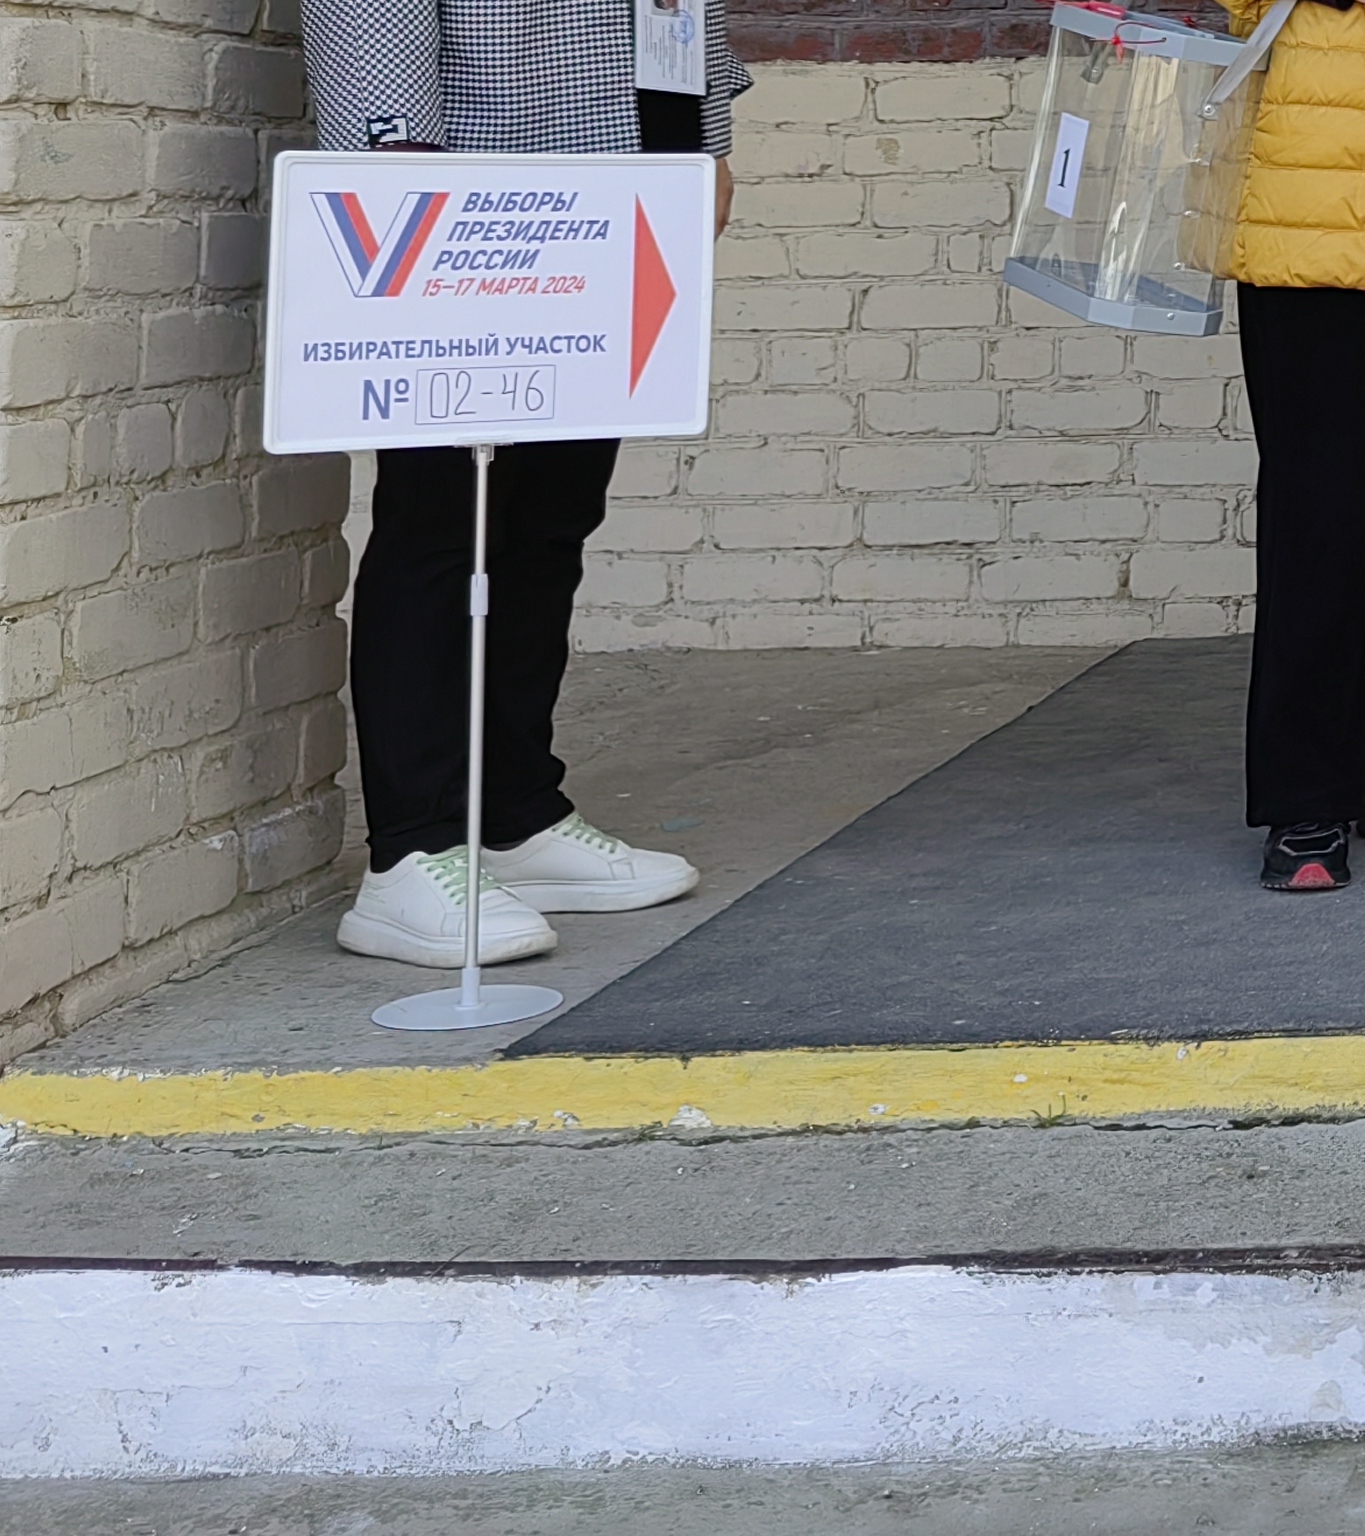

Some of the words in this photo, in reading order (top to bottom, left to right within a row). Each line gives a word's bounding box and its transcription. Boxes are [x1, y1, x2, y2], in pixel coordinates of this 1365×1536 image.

[1057, 148, 1071, 188] 1
[461, 192, 579, 213] ВЫБОРЫ
[446, 220, 611, 244] ПРЕЗИДЕНТА
[432, 249, 541, 272] РОССИИ
[421, 278, 478, 297] 15–17
[477, 276, 541, 296] МАРТА
[541, 276, 586, 294] 2024
[302, 333, 500, 362] ИЗБИРАТЕЛЬНЫЙ
[504, 334, 607, 355] УЧАСТОК
[362, 378, 411, 421] №
[429, 369, 545, 419] 02-46
